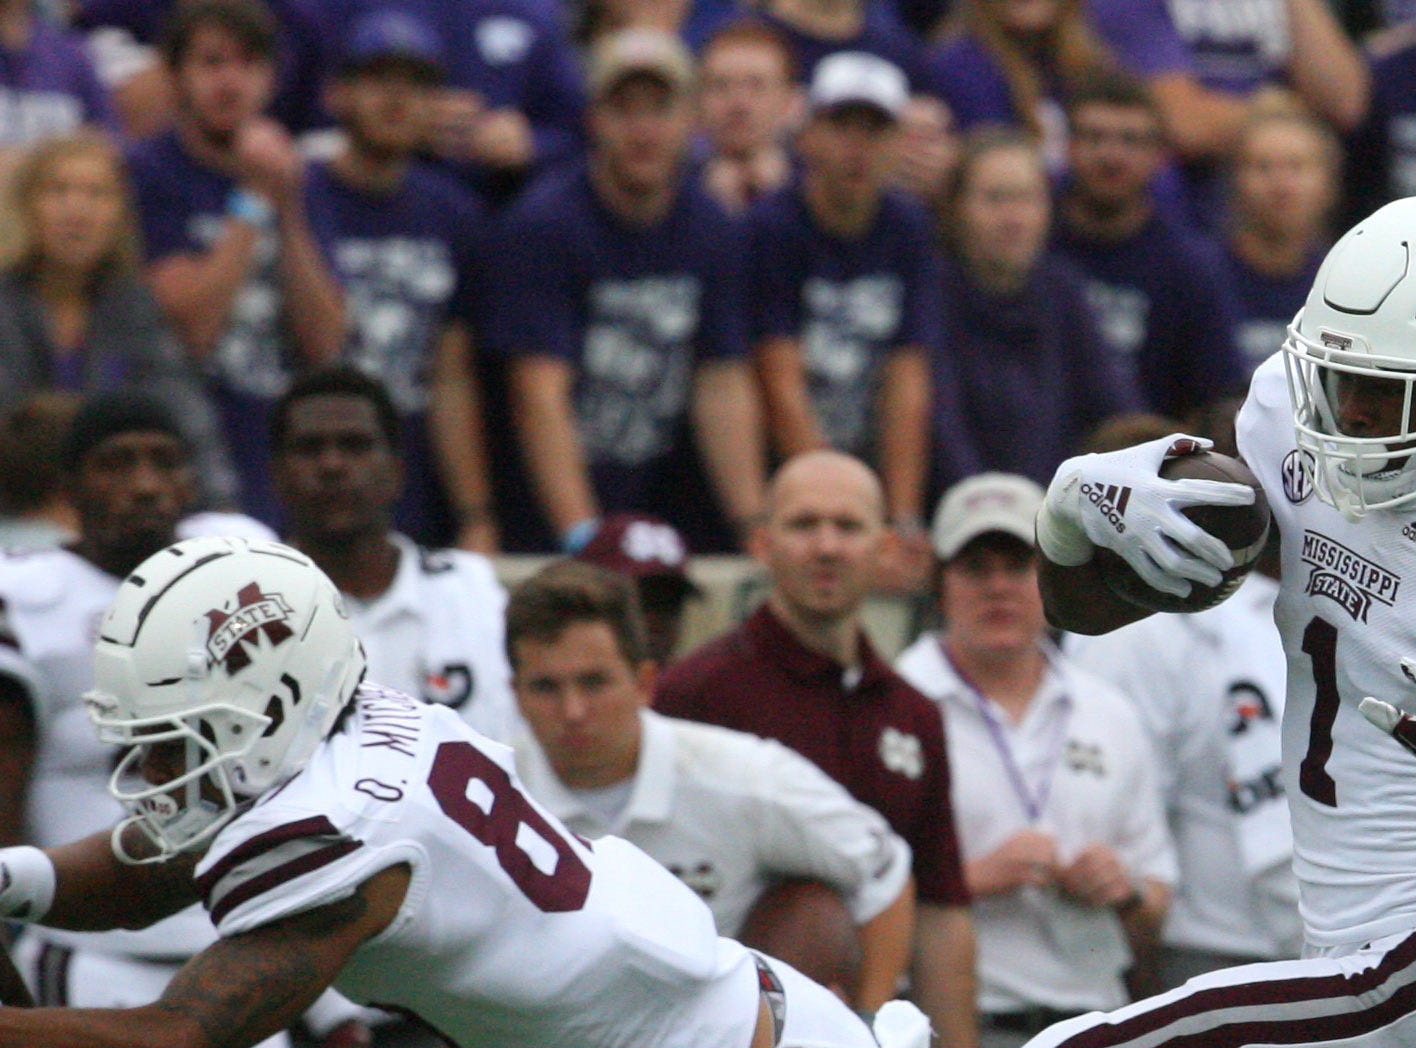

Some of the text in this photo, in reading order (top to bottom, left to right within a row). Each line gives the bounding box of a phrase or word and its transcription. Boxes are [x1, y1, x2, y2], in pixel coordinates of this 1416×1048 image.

[1081, 484, 1126, 533] adidas
[1303, 534, 1401, 602] MISSISSIPPI
[1313, 575, 1358, 613] STATE
[214, 603, 277, 651] STATE
[1300, 616, 1341, 808] 1
[427, 741, 593, 913] 8
